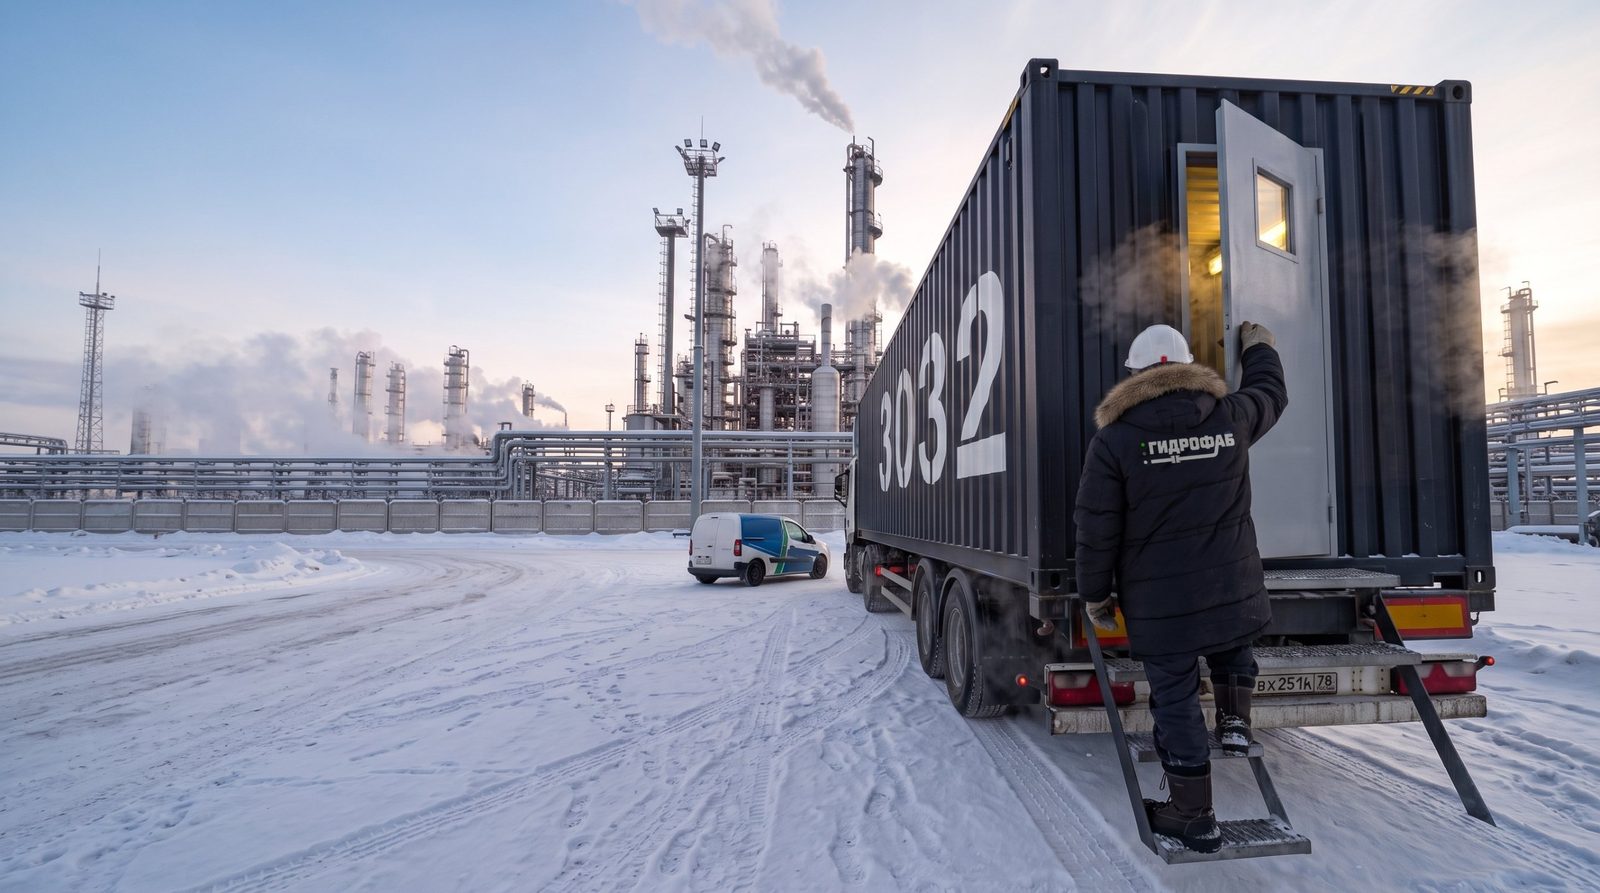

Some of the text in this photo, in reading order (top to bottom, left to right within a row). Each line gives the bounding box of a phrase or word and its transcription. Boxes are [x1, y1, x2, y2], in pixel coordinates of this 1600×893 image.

[879, 270, 1006, 492] 3032
[1148, 433, 1236, 455] ГИДРОФАБ
[1317, 675, 1332, 687] 78
